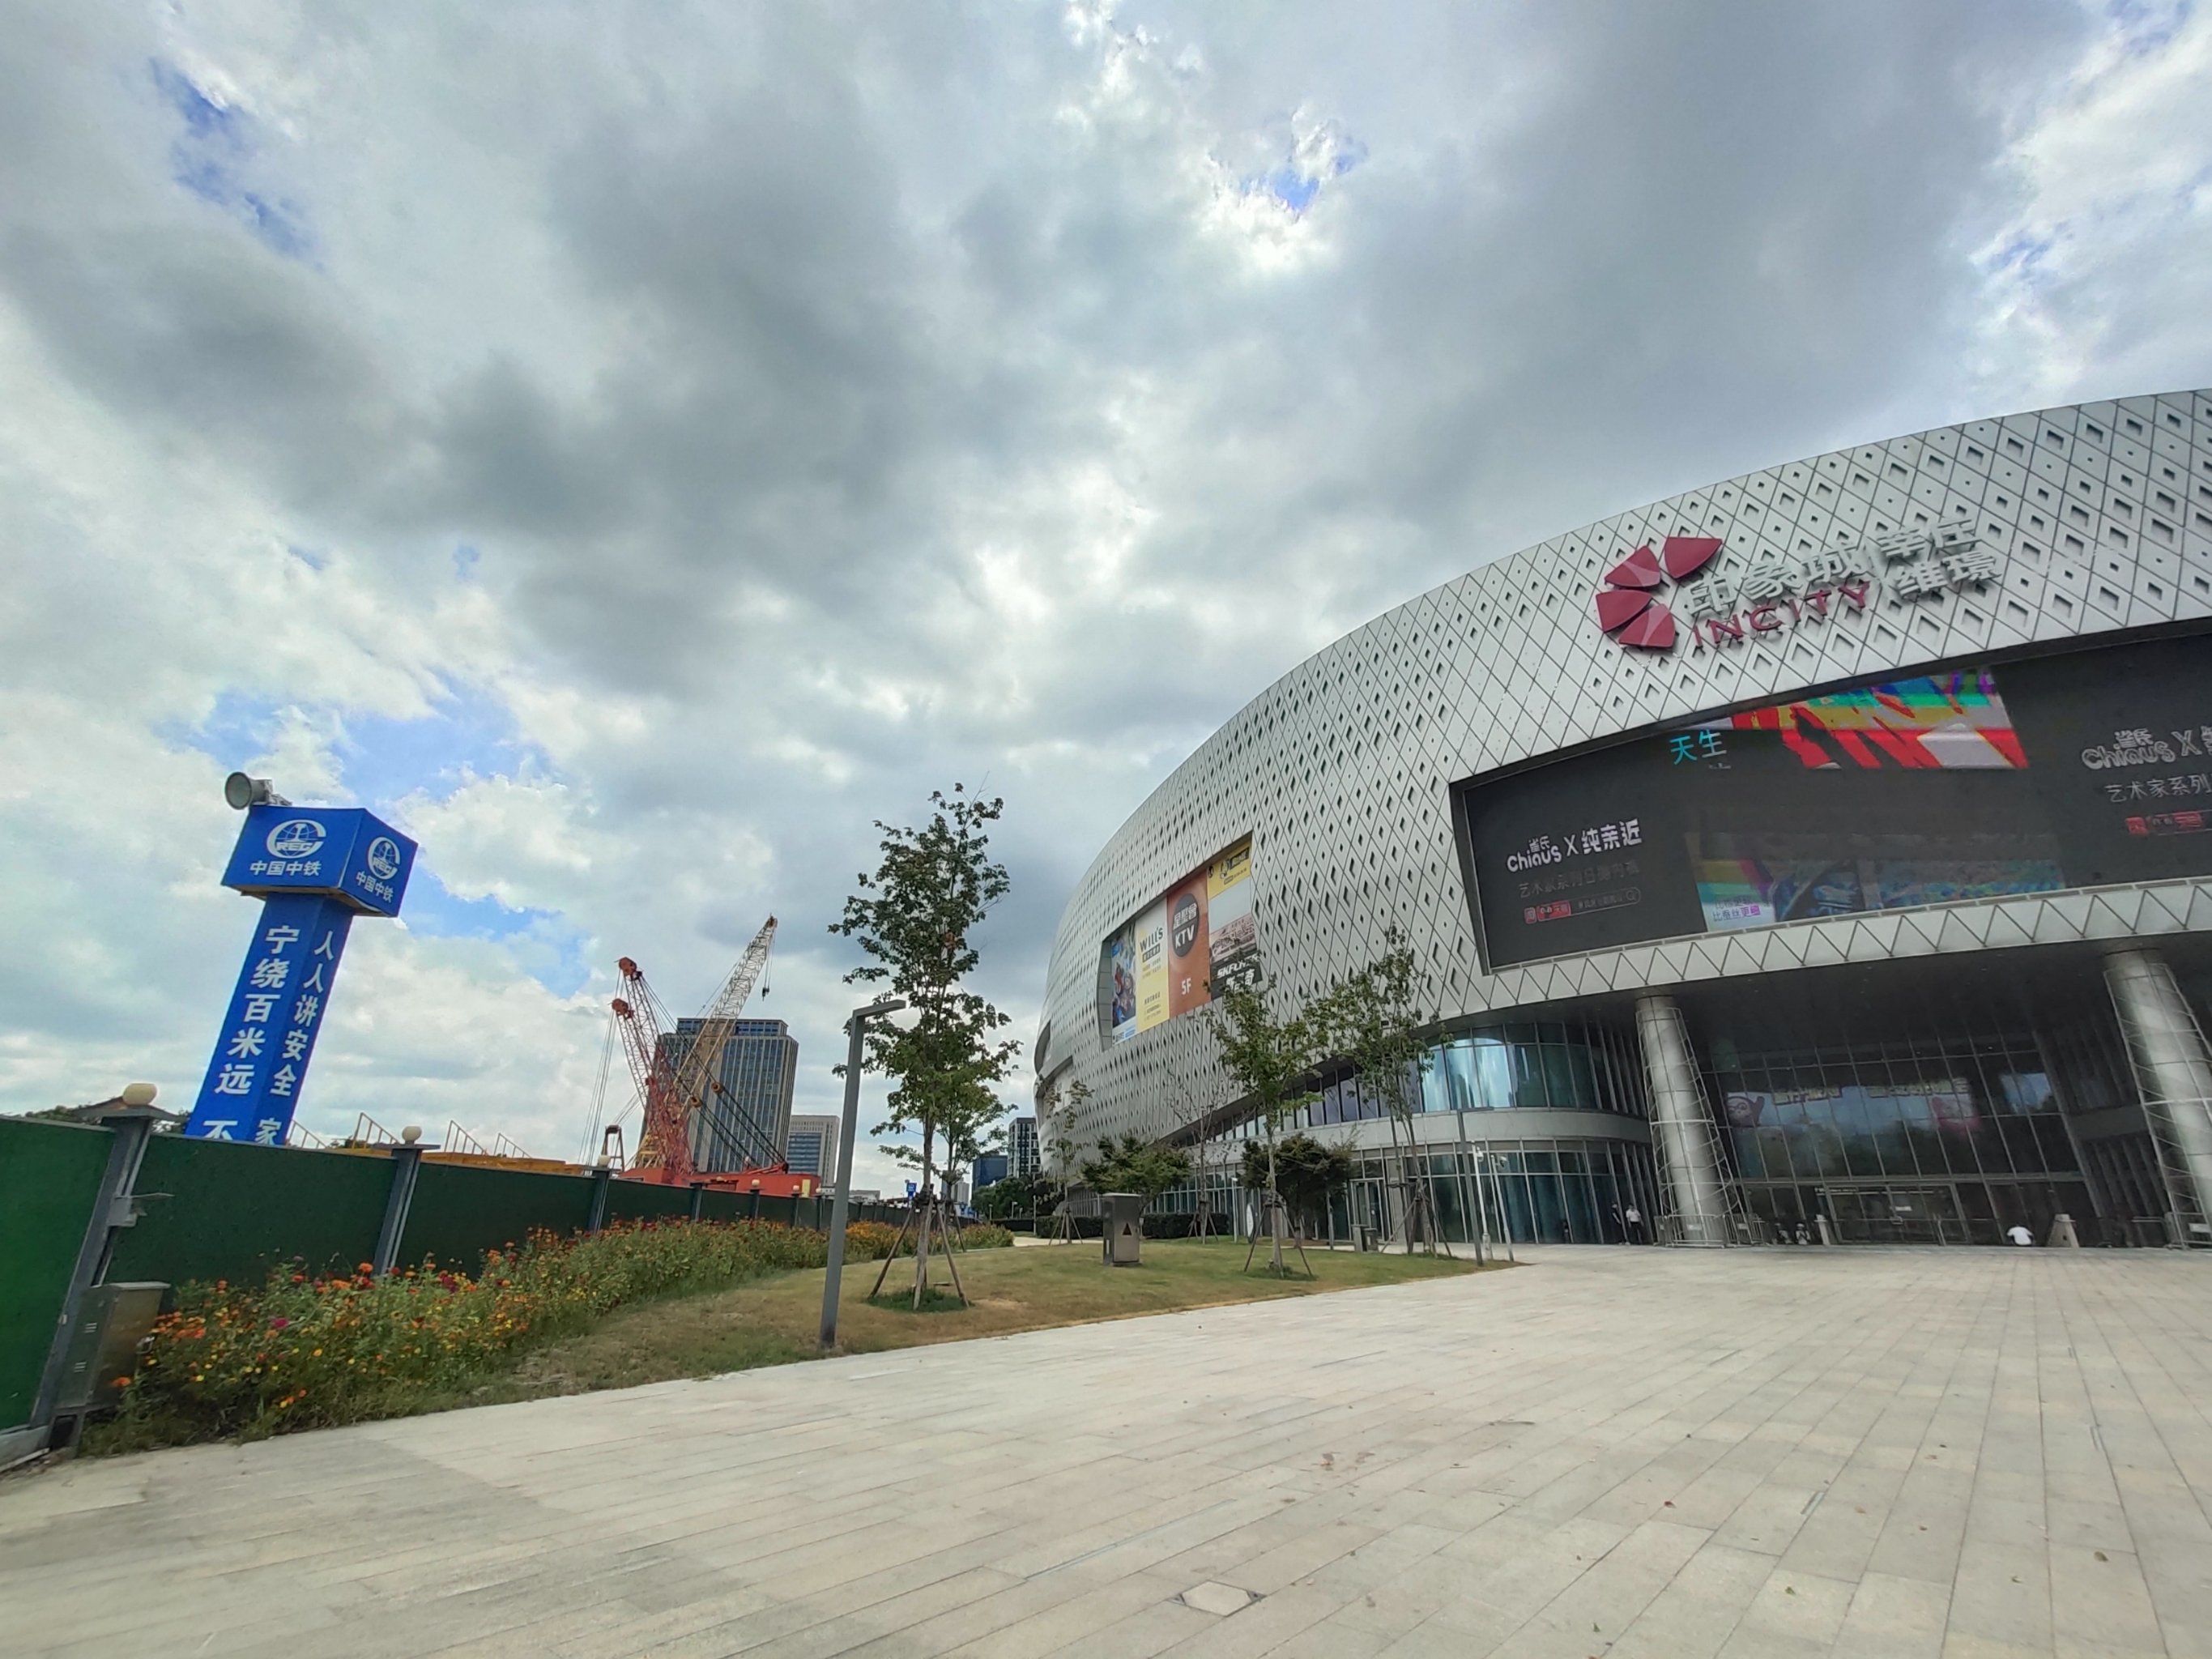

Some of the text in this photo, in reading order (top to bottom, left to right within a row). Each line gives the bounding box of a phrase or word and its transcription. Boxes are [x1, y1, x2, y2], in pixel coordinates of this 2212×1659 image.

[1684, 541, 1876, 617] 印象城
[1693, 580, 1871, 648] INCITY
[1669, 728, 1728, 765] 天生
[1507, 817, 1643, 872] Chiaus X 纯亲近
[249, 859, 322, 877] 中国中铁
[356, 871, 394, 904] 中国中铁
[1174, 923, 1195, 949] KTV
[1182, 977, 1191, 996] 5F
[203, 924, 300, 1141] 宁绕百米远 不
[254, 930, 335, 1146] 人人讲安全 家
